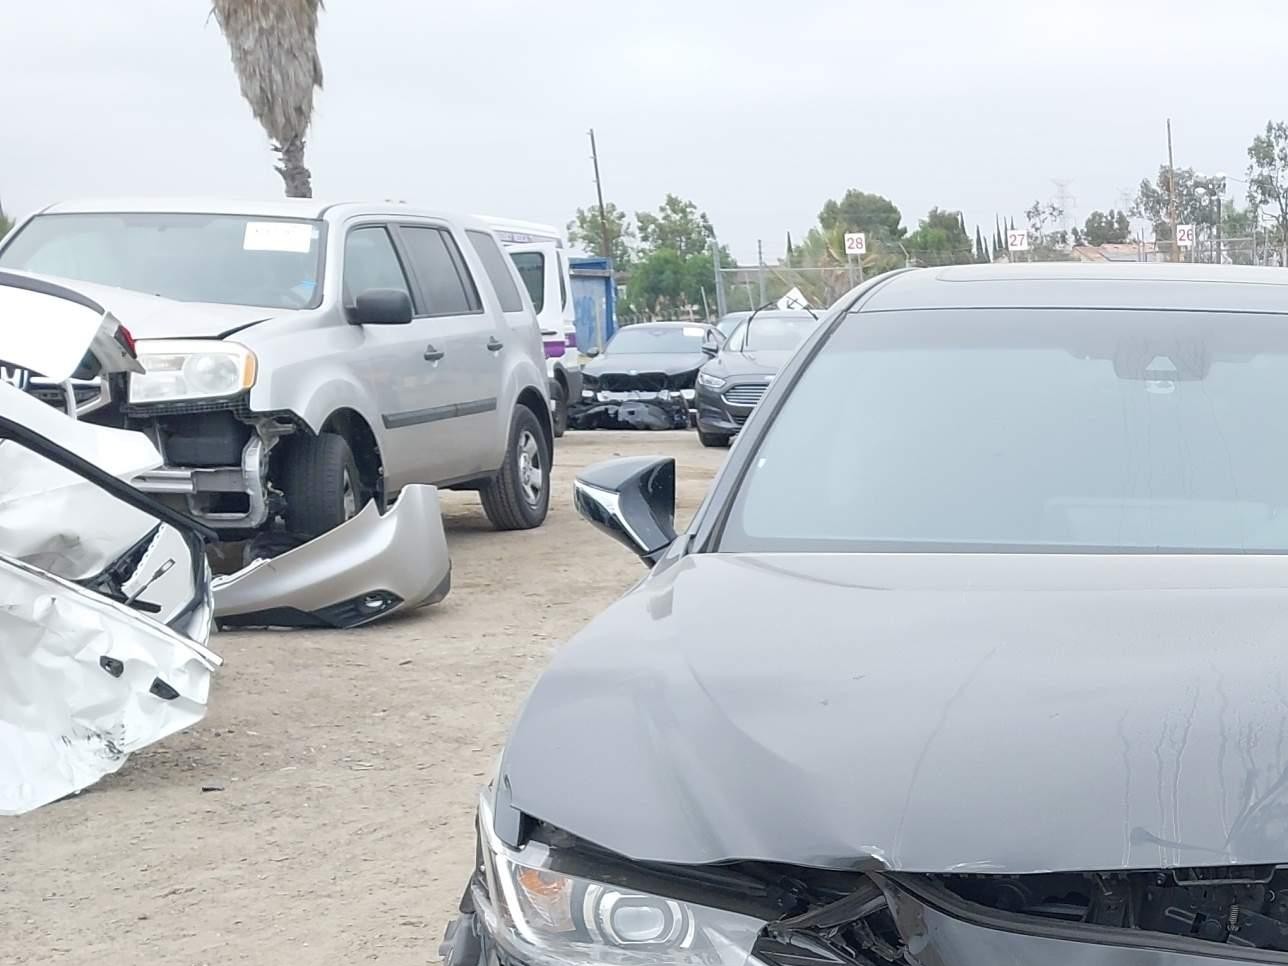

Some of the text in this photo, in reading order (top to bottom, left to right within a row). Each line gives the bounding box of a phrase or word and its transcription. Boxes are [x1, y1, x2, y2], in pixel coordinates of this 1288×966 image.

[1009, 233, 1025, 246] 27
[1178, 228, 1193, 241] 26
[847, 236, 864, 249] 28
